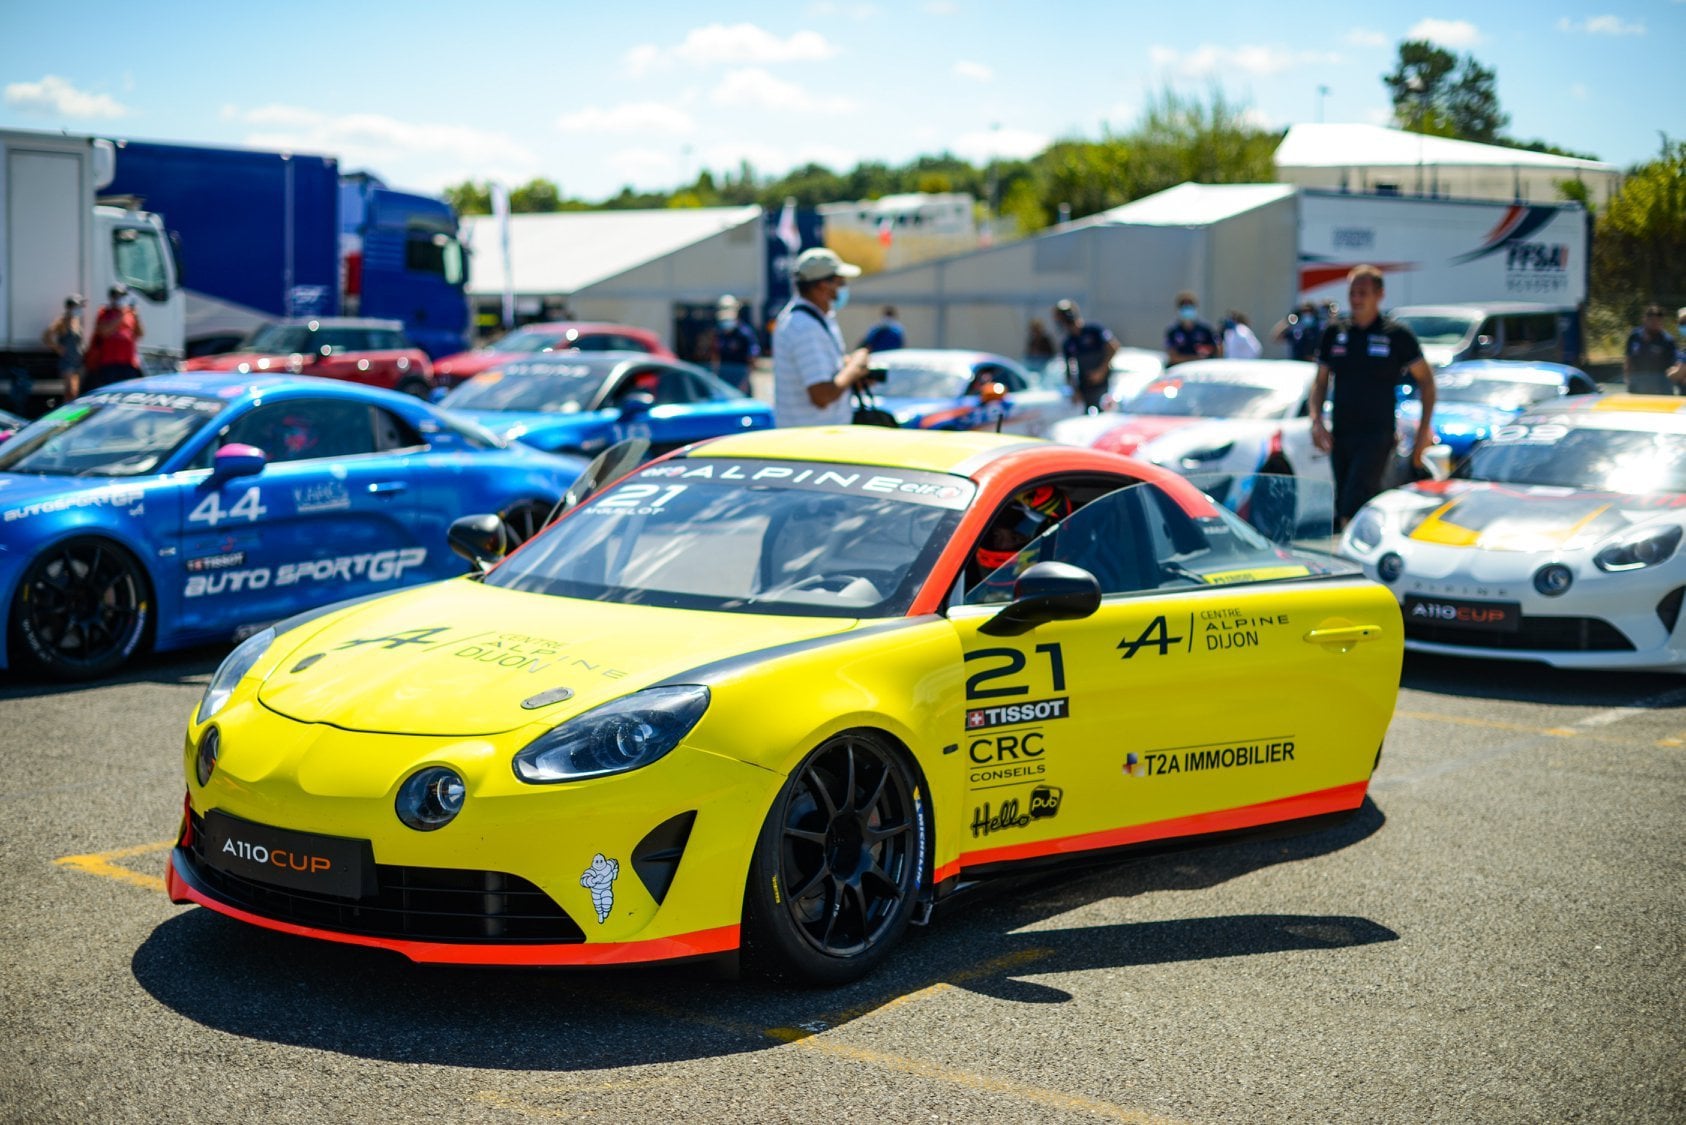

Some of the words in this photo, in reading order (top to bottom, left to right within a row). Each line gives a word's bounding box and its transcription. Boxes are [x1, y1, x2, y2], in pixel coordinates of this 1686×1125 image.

[681, 465, 903, 493] ALPINE
[188, 486, 267, 526] 44
[595, 484, 689, 507] 21
[1200, 608, 1242, 620] CENTRE
[1206, 614, 1289, 631] ALPINE
[1206, 631, 1258, 650] DIJON
[455, 646, 550, 673] DIJON
[963, 642, 1066, 700] 21
[985, 700, 1065, 725] TISSOT
[969, 733, 1045, 763] CRC
[1144, 753, 1180, 776] T2A
[1184, 742, 1295, 772] IMMOBILIER
[970, 764, 1046, 783] CONSEILS
[971, 798, 1031, 838] Hello
